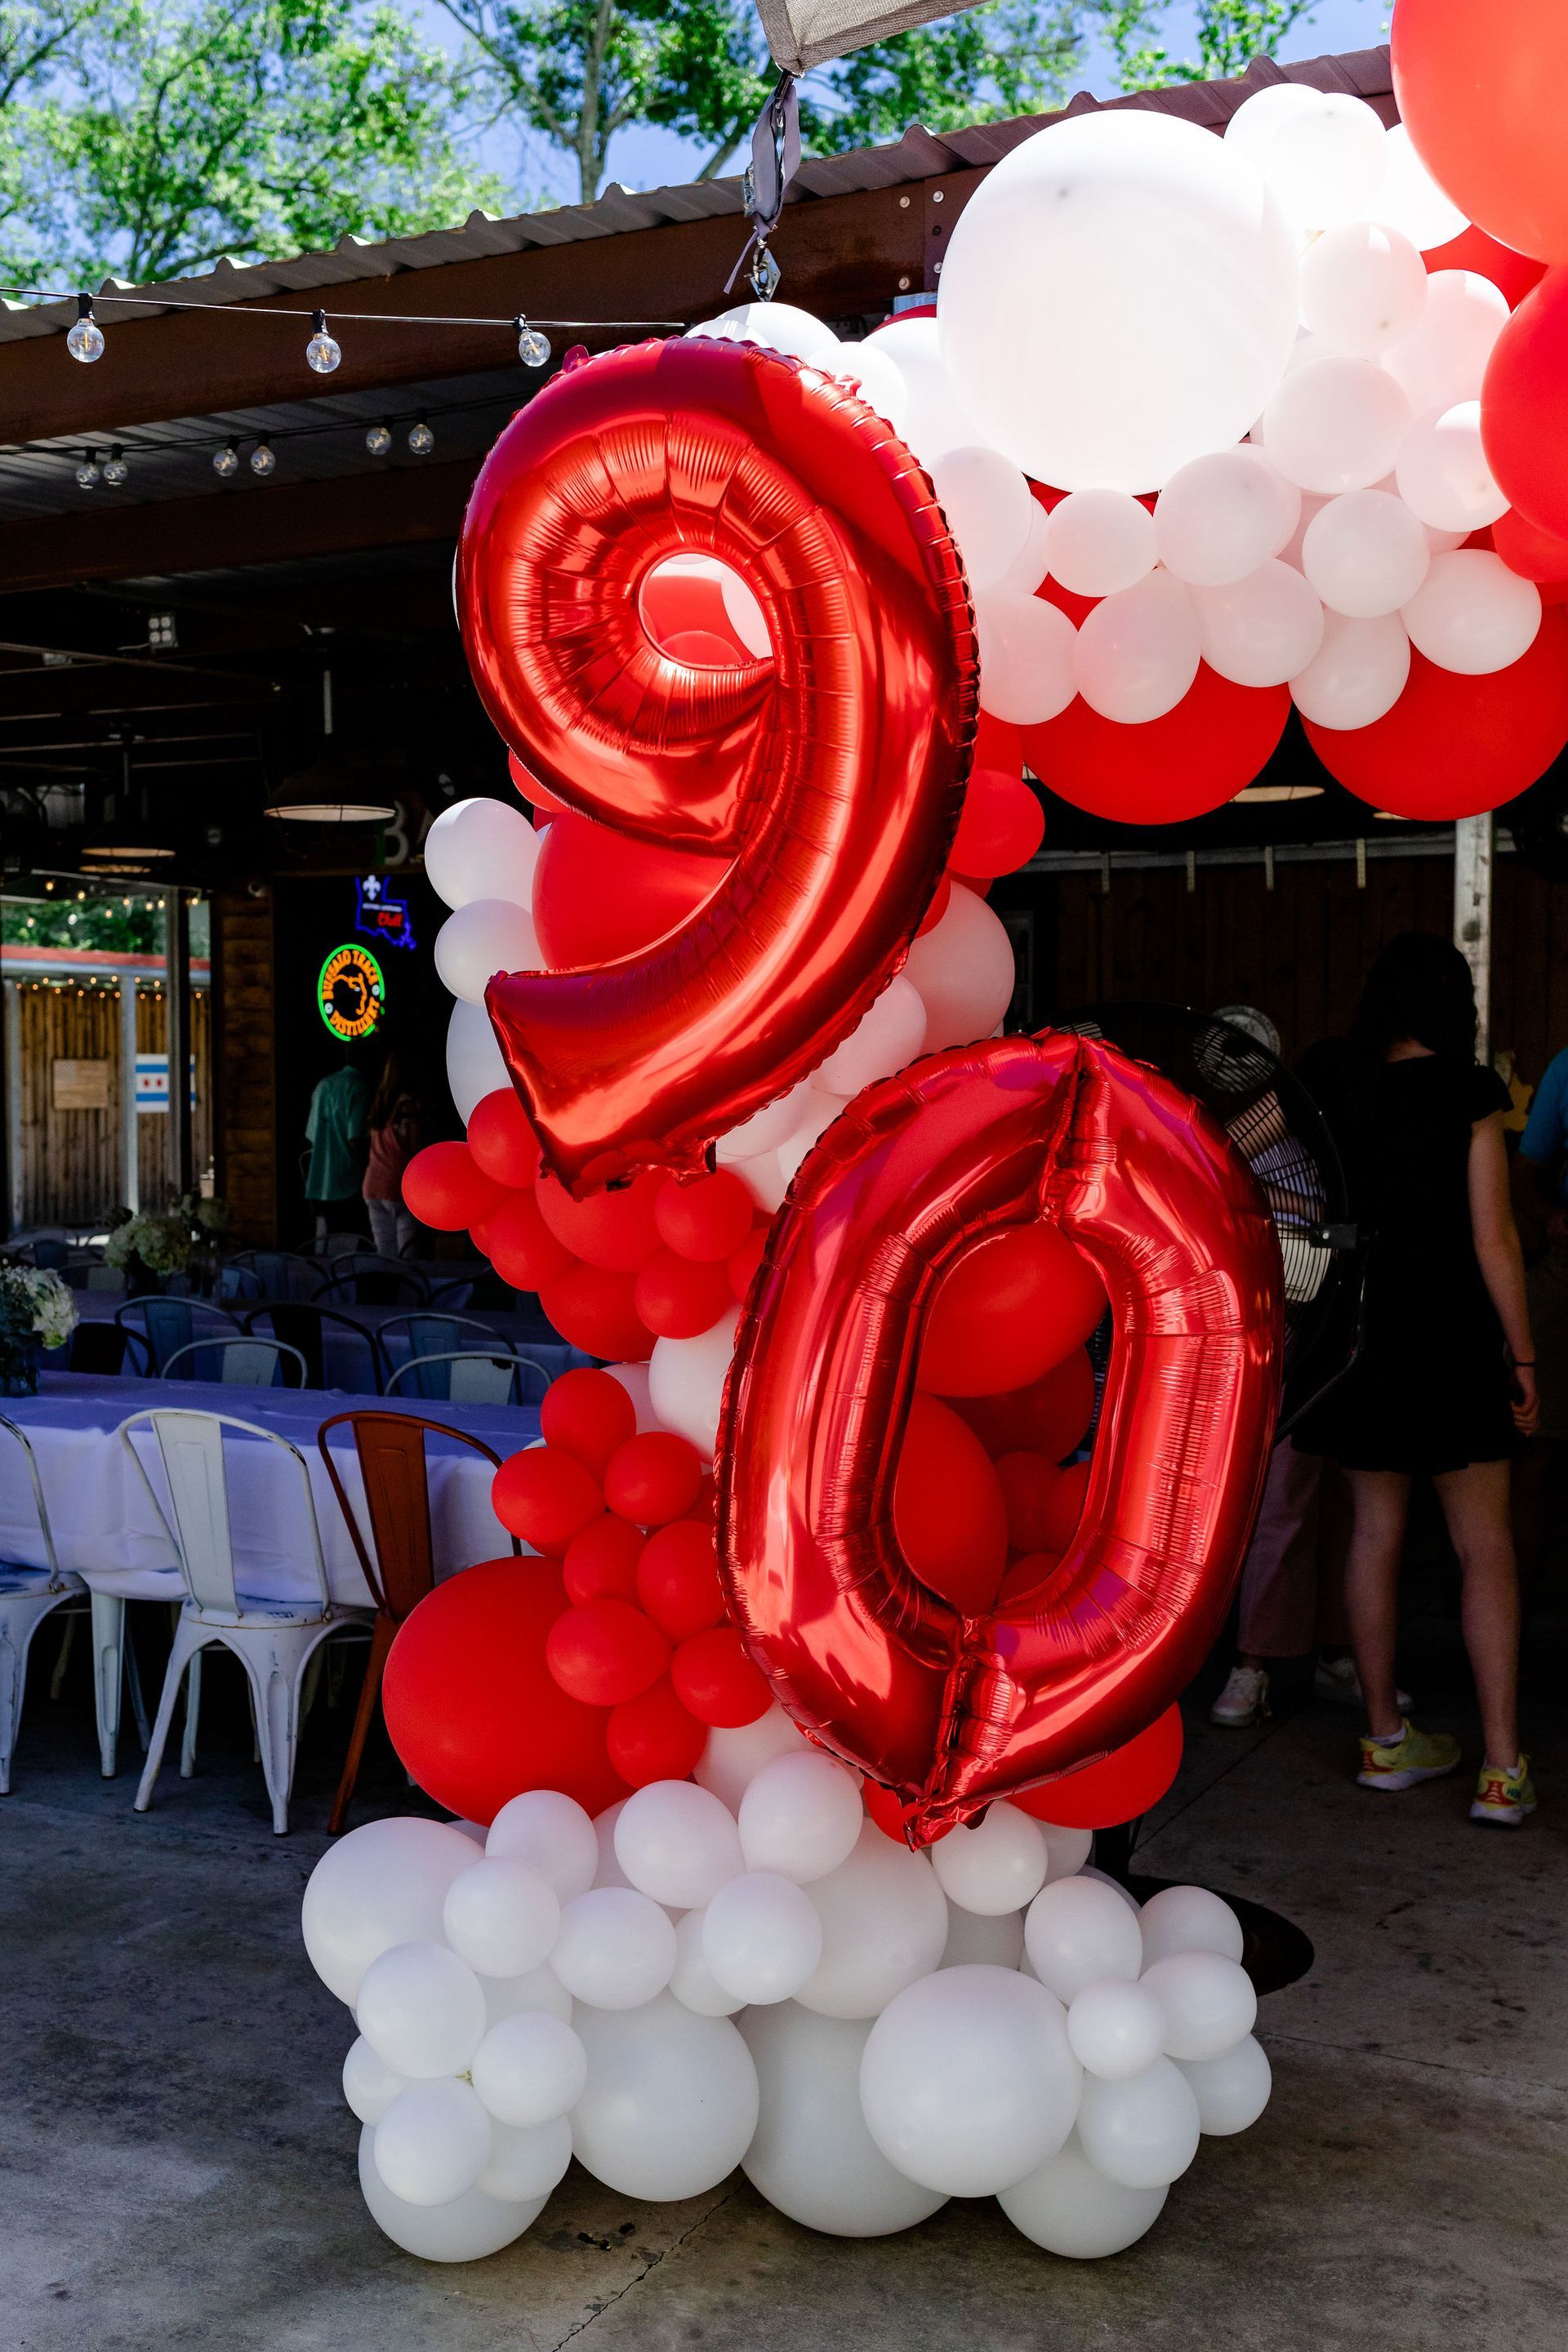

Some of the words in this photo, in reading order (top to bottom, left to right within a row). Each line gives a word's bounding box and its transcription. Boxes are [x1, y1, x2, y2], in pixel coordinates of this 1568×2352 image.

[322, 949, 352, 1000] BUFFALO
[352, 949, 379, 986] TRACE
[455, 335, 979, 1200] 9
